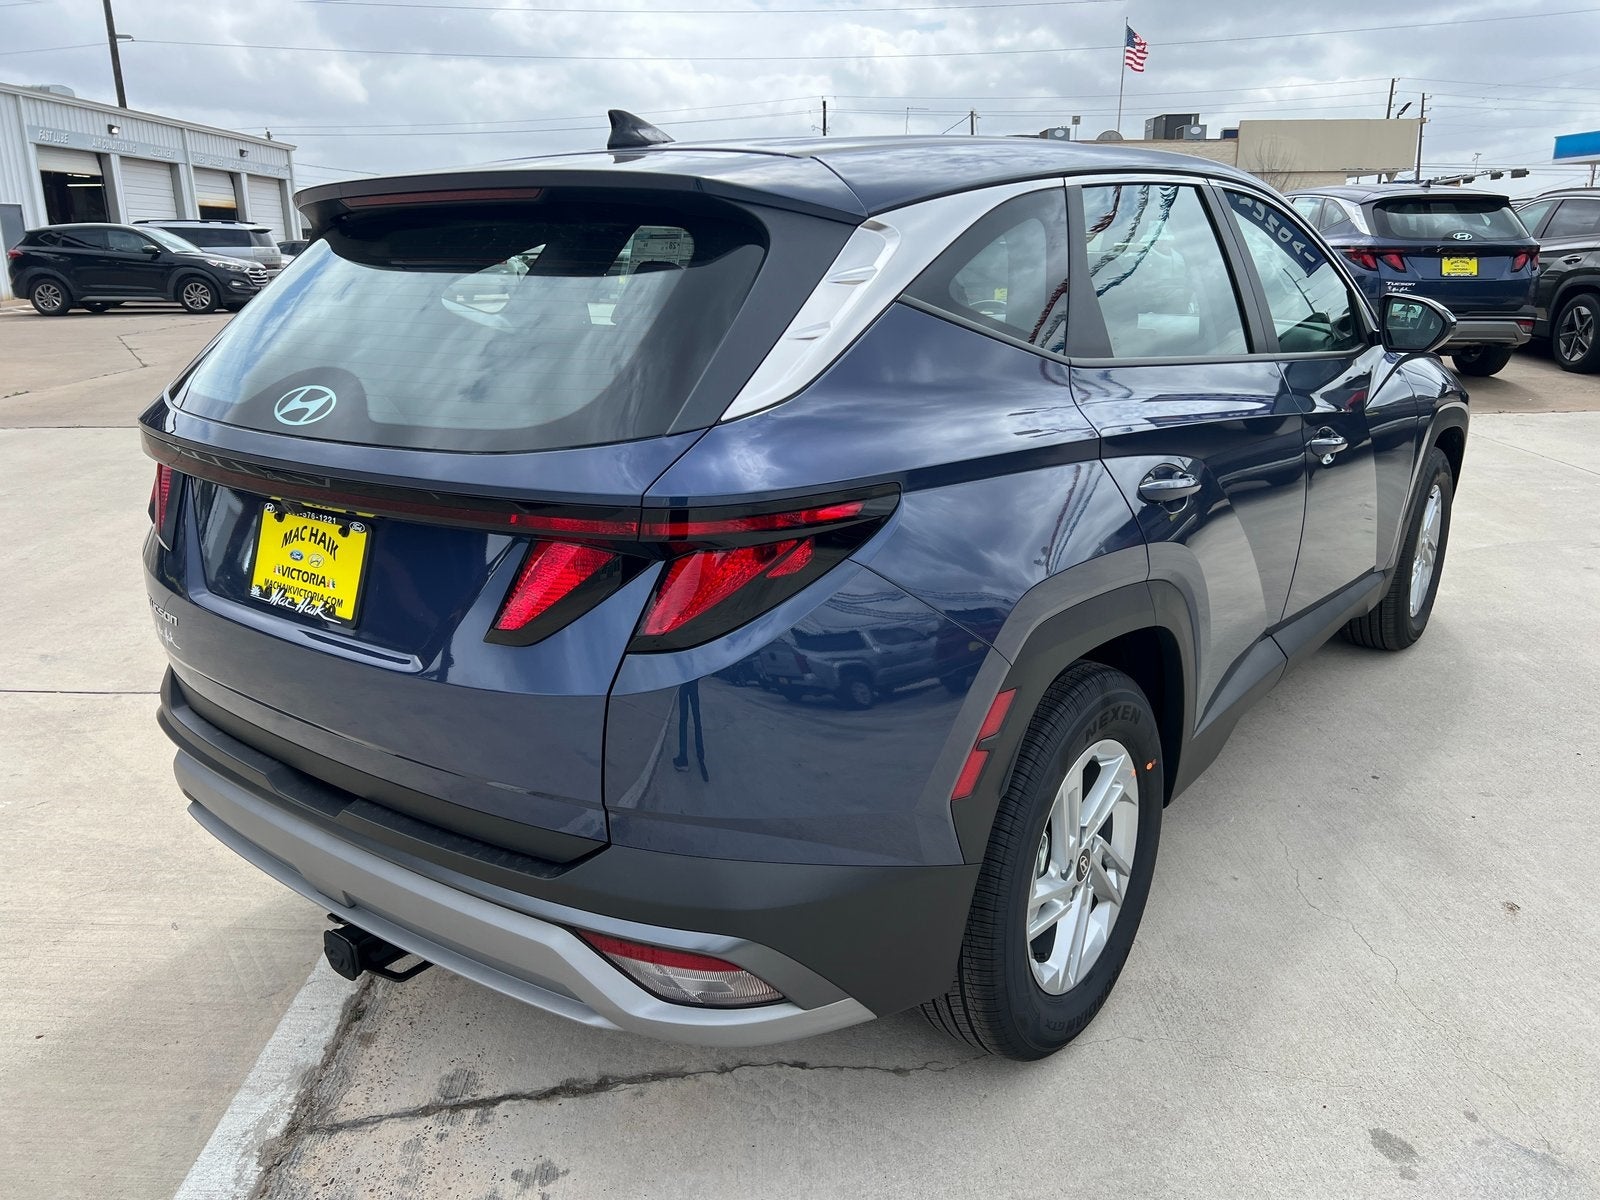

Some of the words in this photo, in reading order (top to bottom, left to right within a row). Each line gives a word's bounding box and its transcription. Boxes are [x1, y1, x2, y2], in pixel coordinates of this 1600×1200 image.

[39, 129, 53, 142] FAST
[54, 131, 69, 144] LUBE
[281, 526, 308, 548] MAC
[309, 527, 339, 561] HAIK
[280, 565, 327, 588] VICTORIA
[1085, 704, 1142, 743] NEXEN
